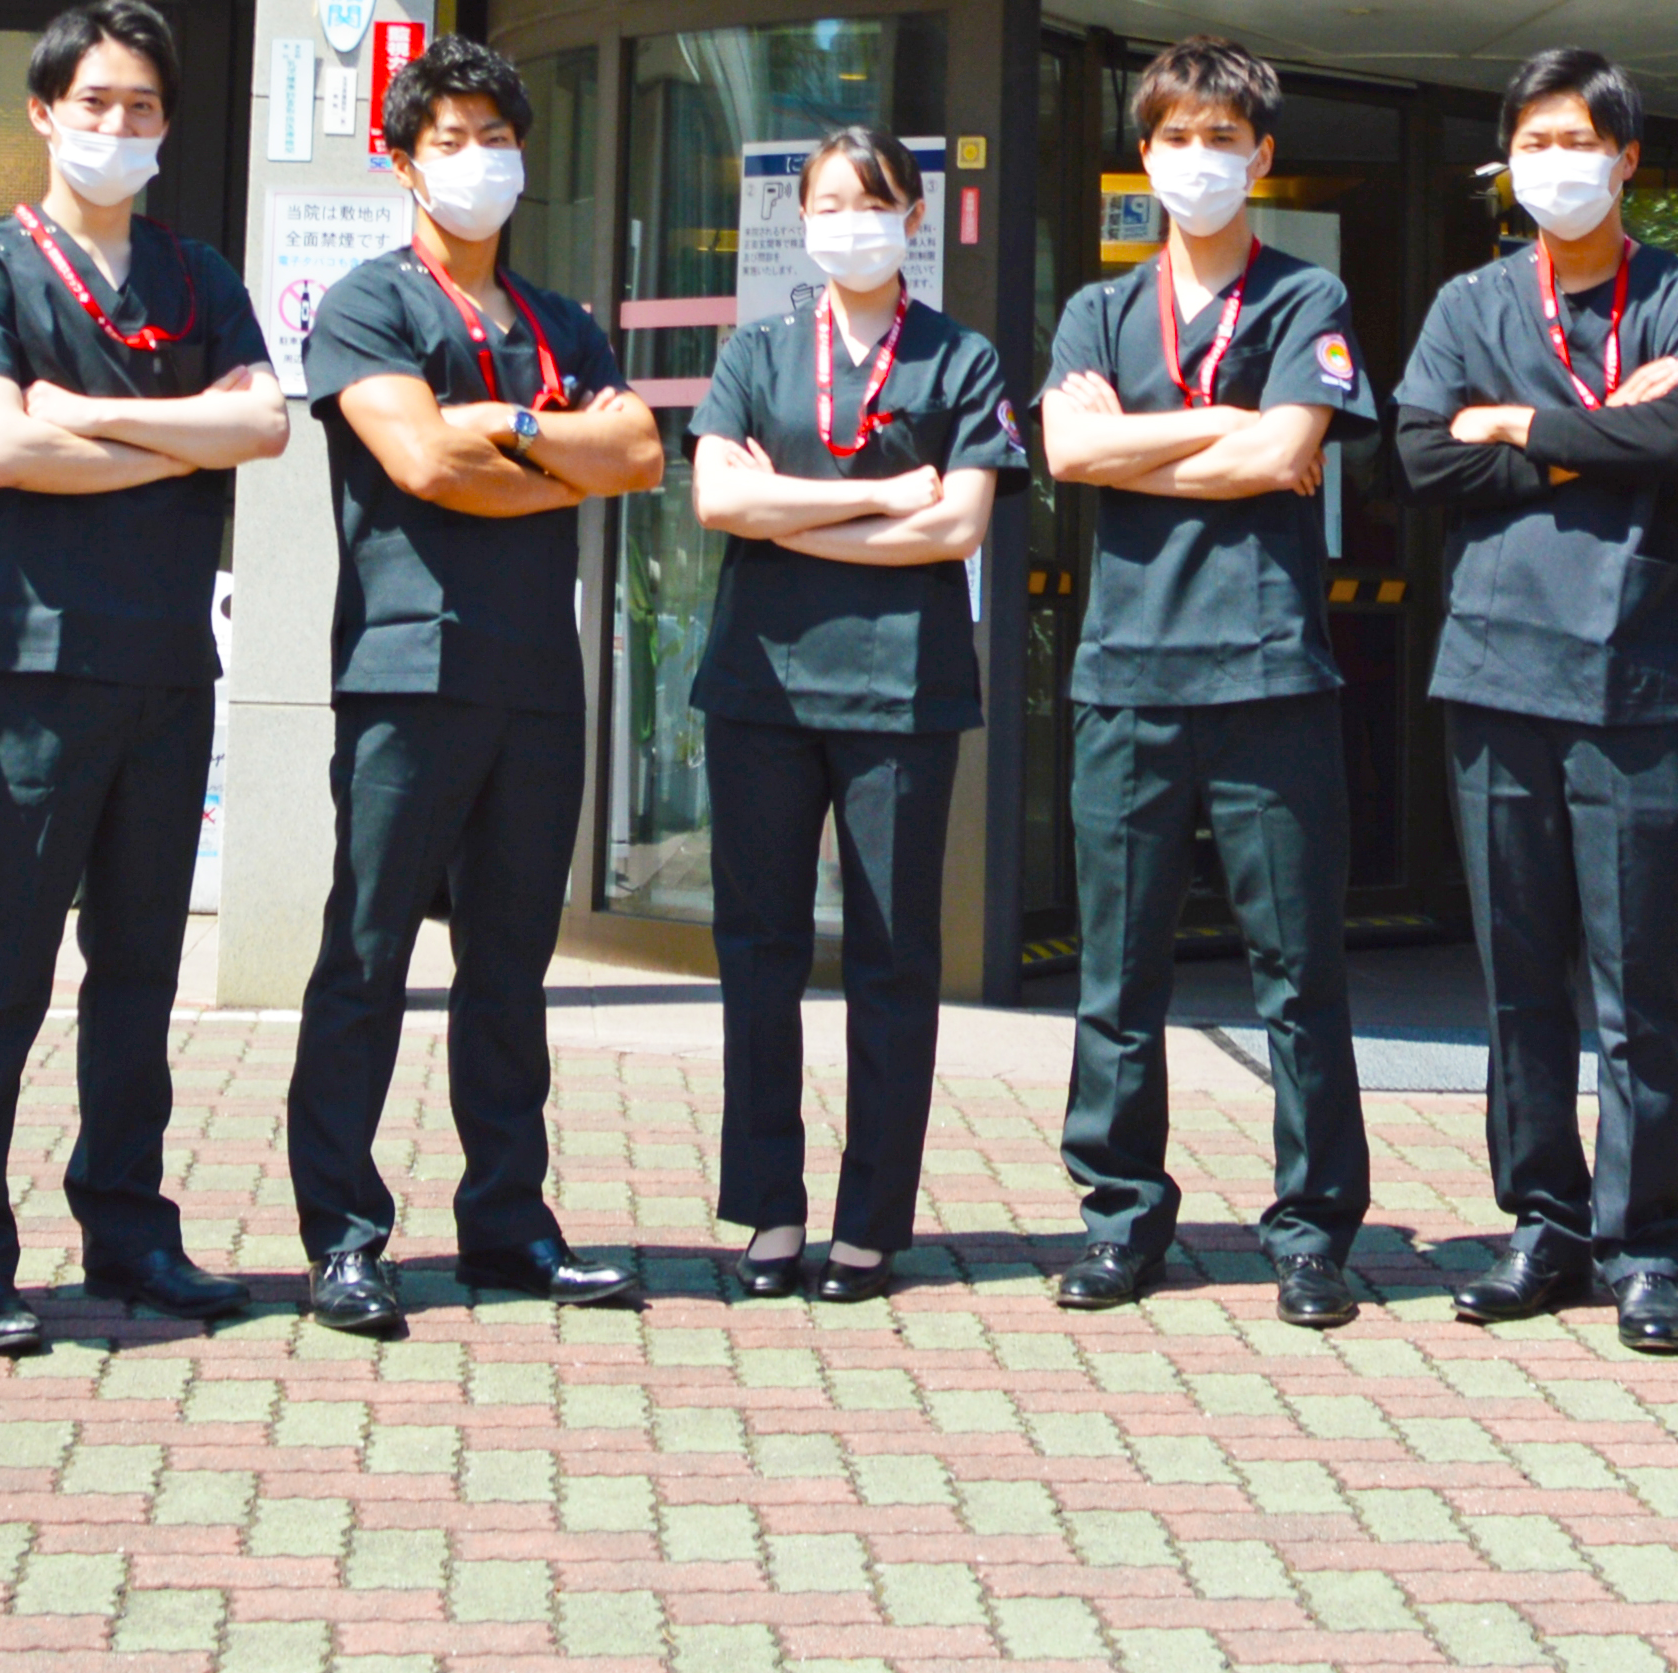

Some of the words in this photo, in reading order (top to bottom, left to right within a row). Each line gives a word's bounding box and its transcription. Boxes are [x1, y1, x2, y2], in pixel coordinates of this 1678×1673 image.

[287, 204, 391, 223] 当院は敷地内
[286, 230, 391, 248] 全面禁煙です
